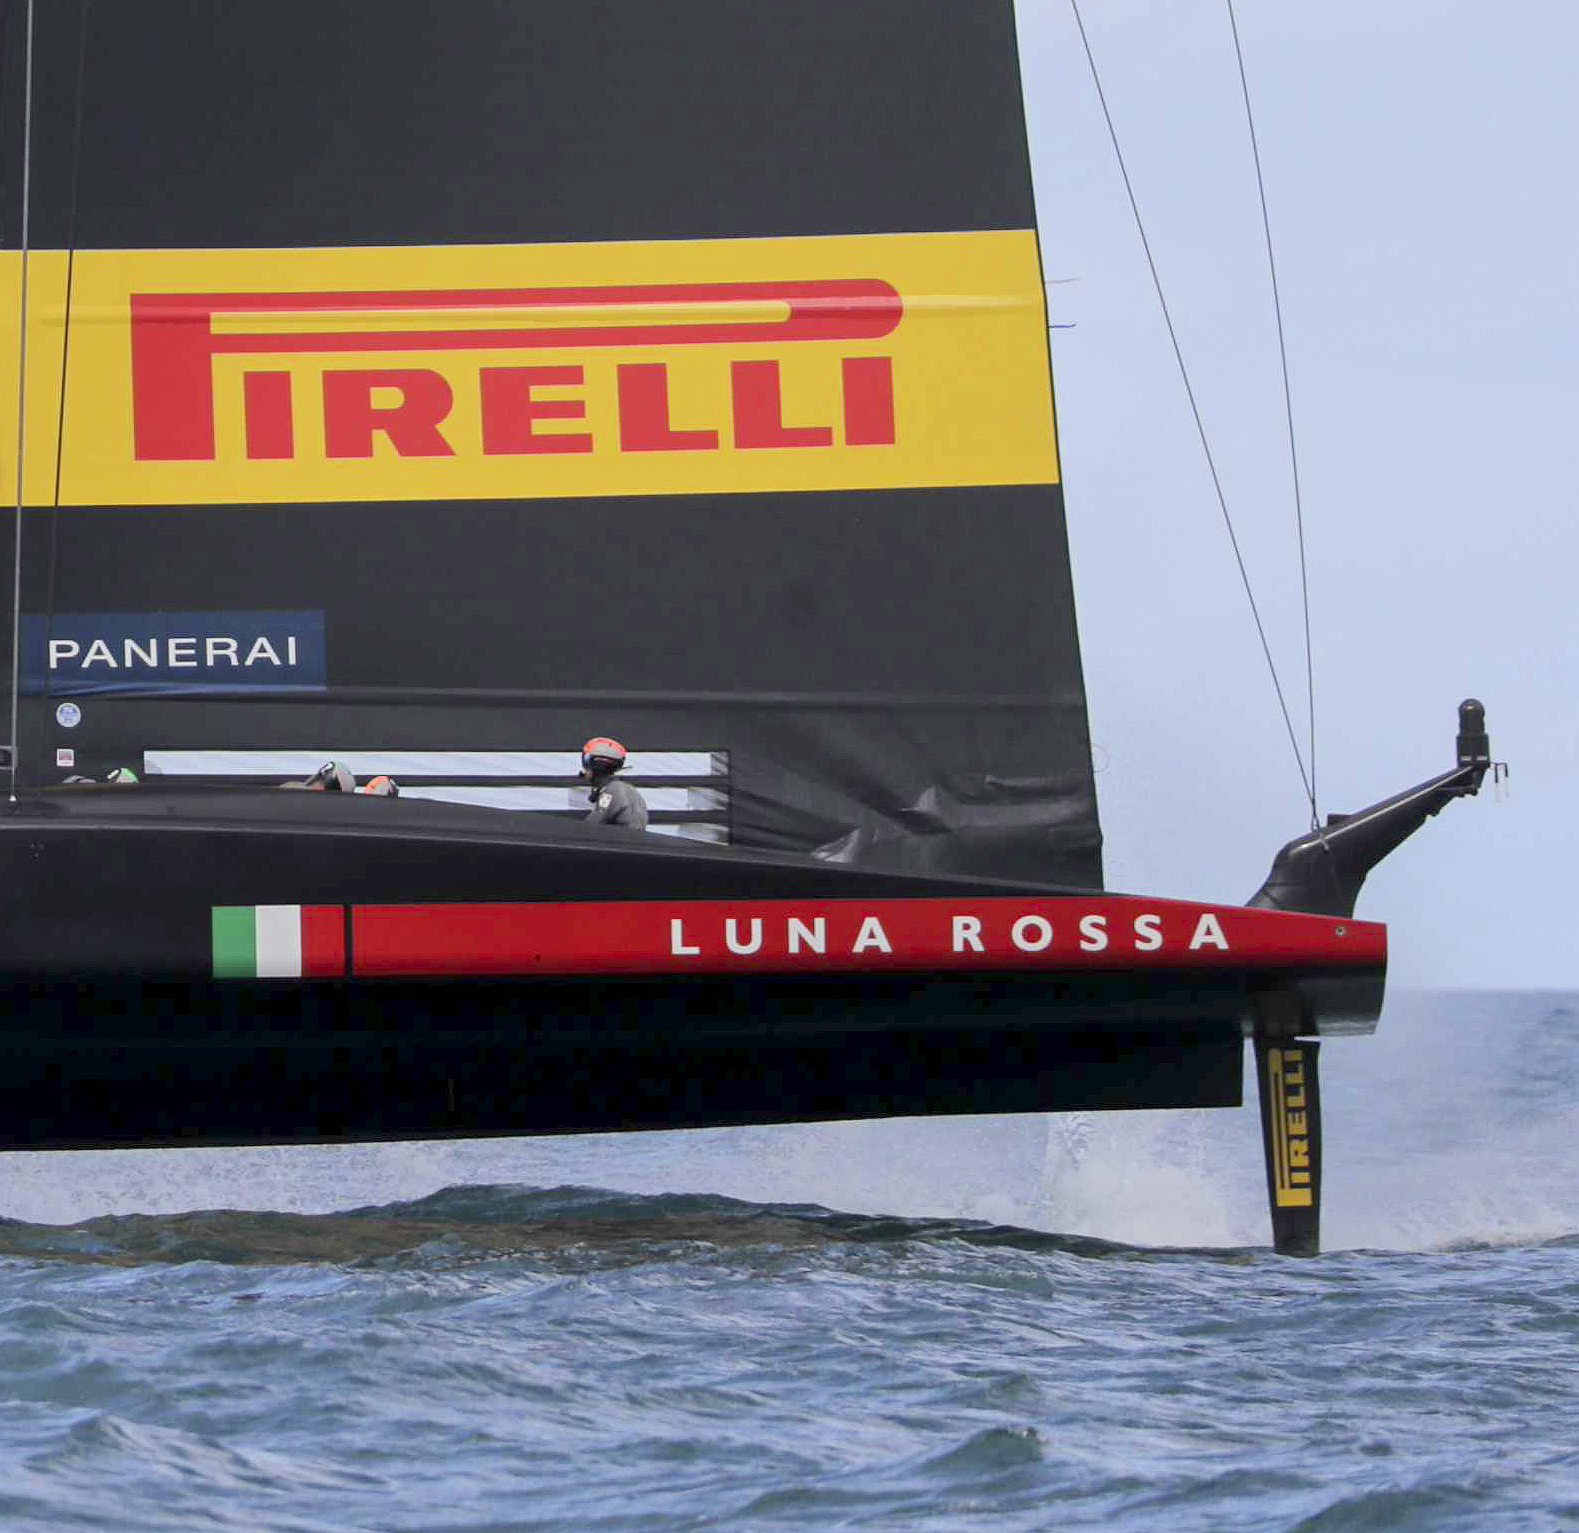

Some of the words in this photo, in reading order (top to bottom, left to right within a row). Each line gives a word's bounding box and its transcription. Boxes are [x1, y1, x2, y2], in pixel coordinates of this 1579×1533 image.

[130, 277, 904, 462] PIRELLI
[48, 636, 298, 669] PANERAI
[670, 916, 893, 956] LUNA
[952, 912, 1230, 953] ROSSA
[1267, 1047, 1313, 1207] PIRELLI
